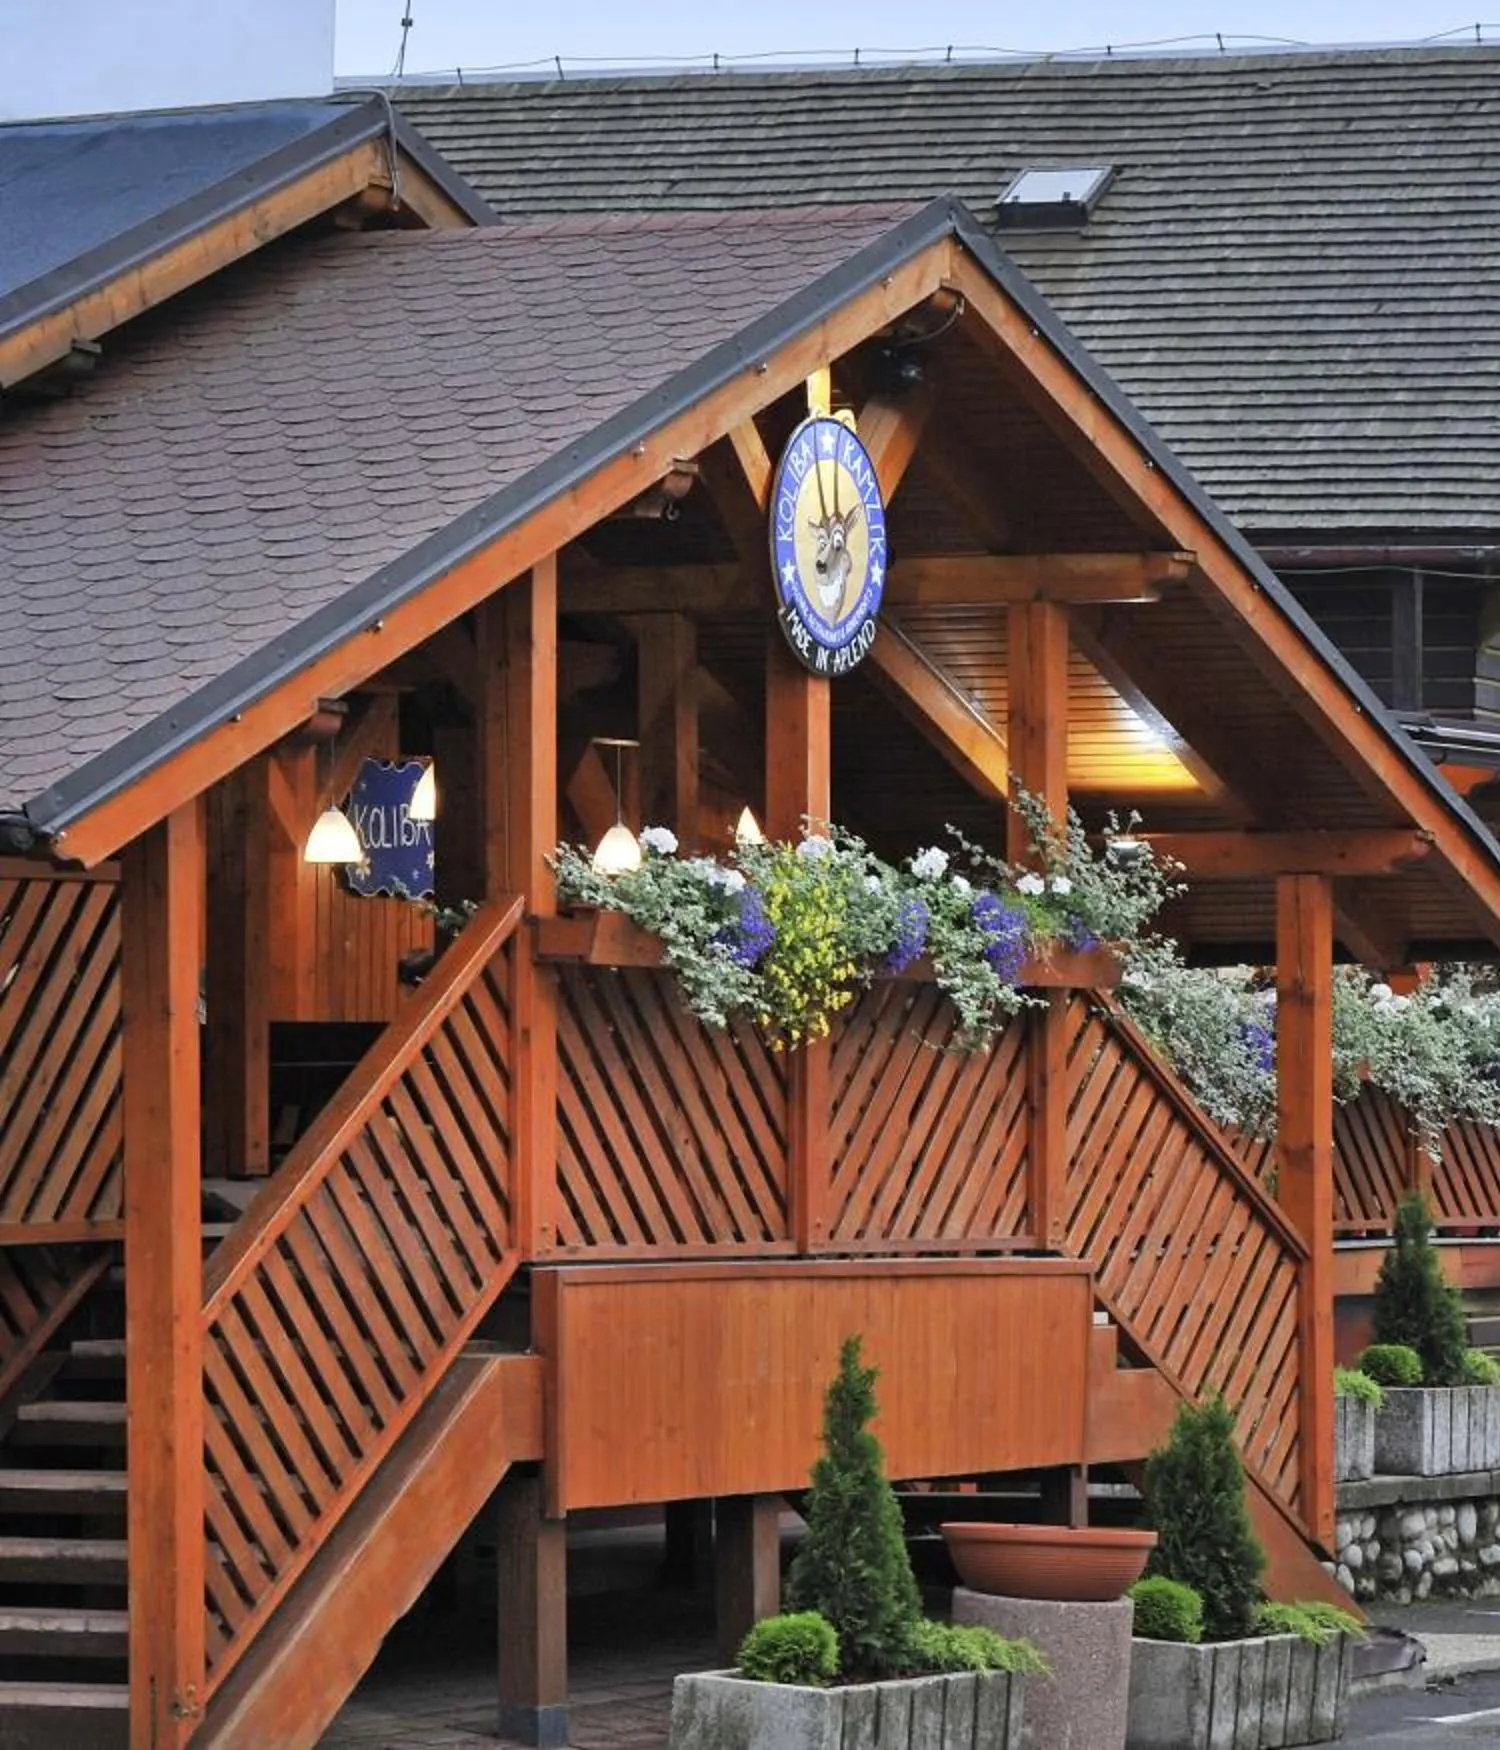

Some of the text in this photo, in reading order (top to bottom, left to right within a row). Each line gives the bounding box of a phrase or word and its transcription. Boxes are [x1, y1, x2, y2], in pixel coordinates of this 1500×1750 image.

[777, 438, 815, 542] KOLIBA
[787, 608, 812, 659] MADE
[815, 646, 829, 672] IN
